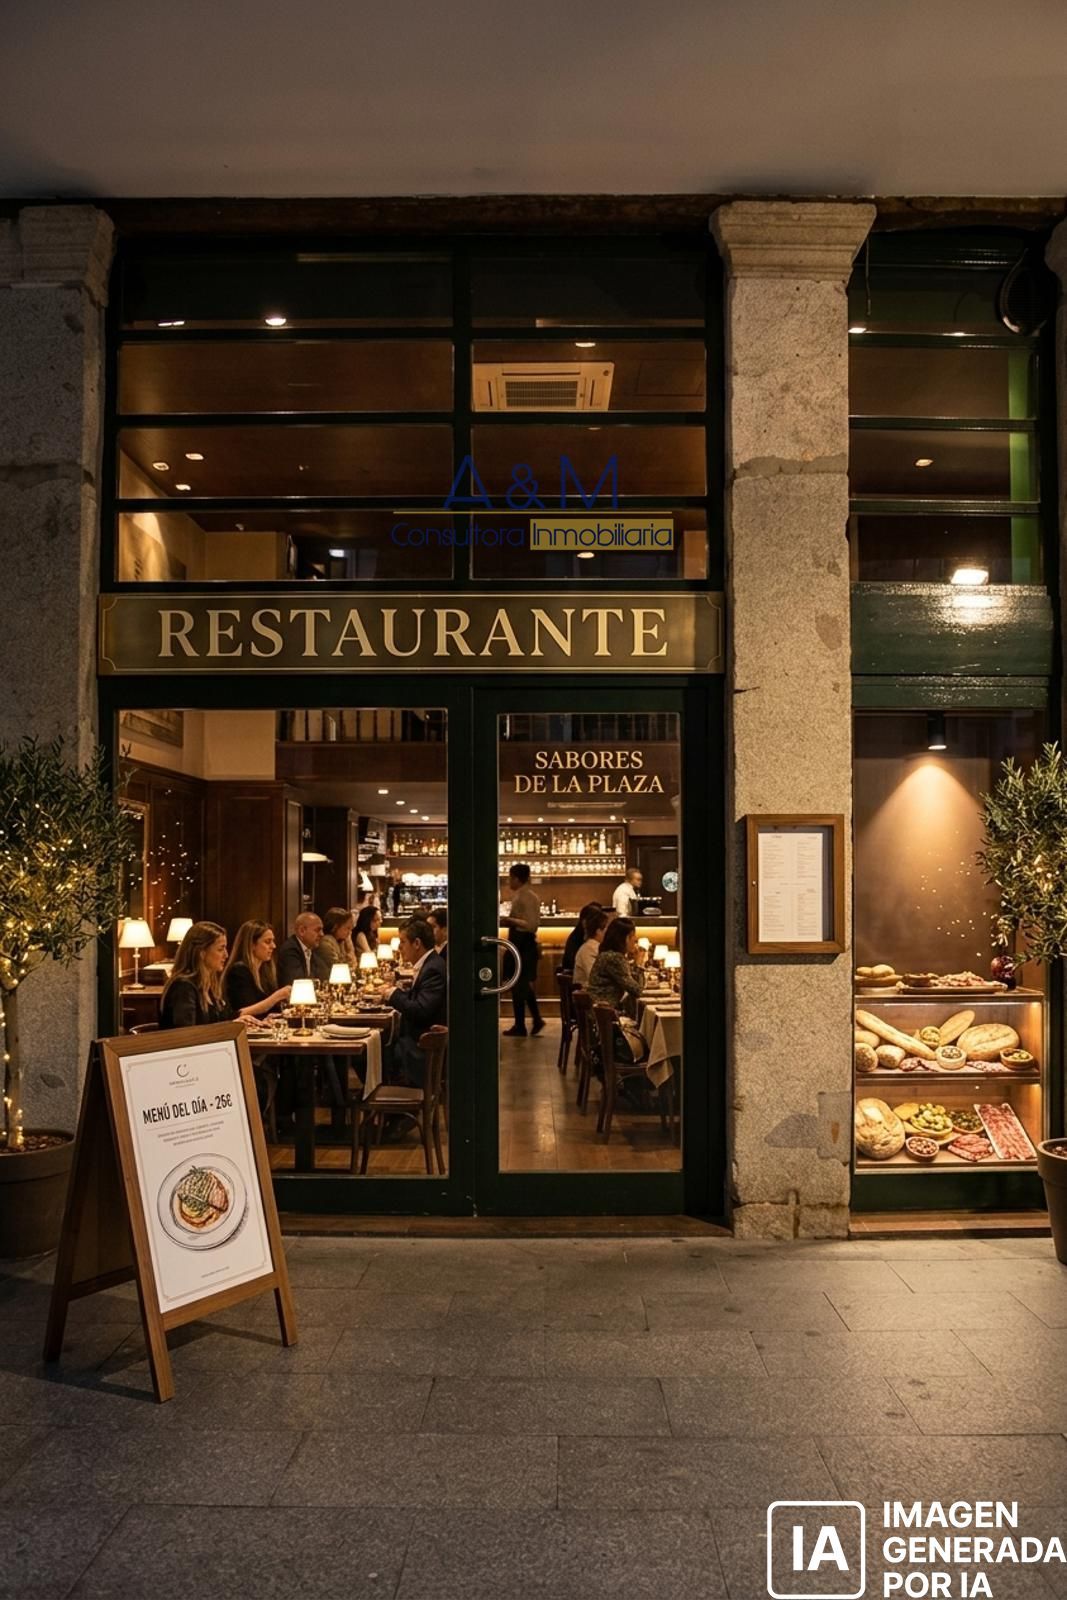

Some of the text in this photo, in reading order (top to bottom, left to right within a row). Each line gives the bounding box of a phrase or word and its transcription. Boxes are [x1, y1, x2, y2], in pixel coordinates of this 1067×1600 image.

[157, 607, 669, 658] RESTAURANTE
[535, 751, 644, 770] SABORES
[514, 774, 665, 794] DE LA PLAZA
